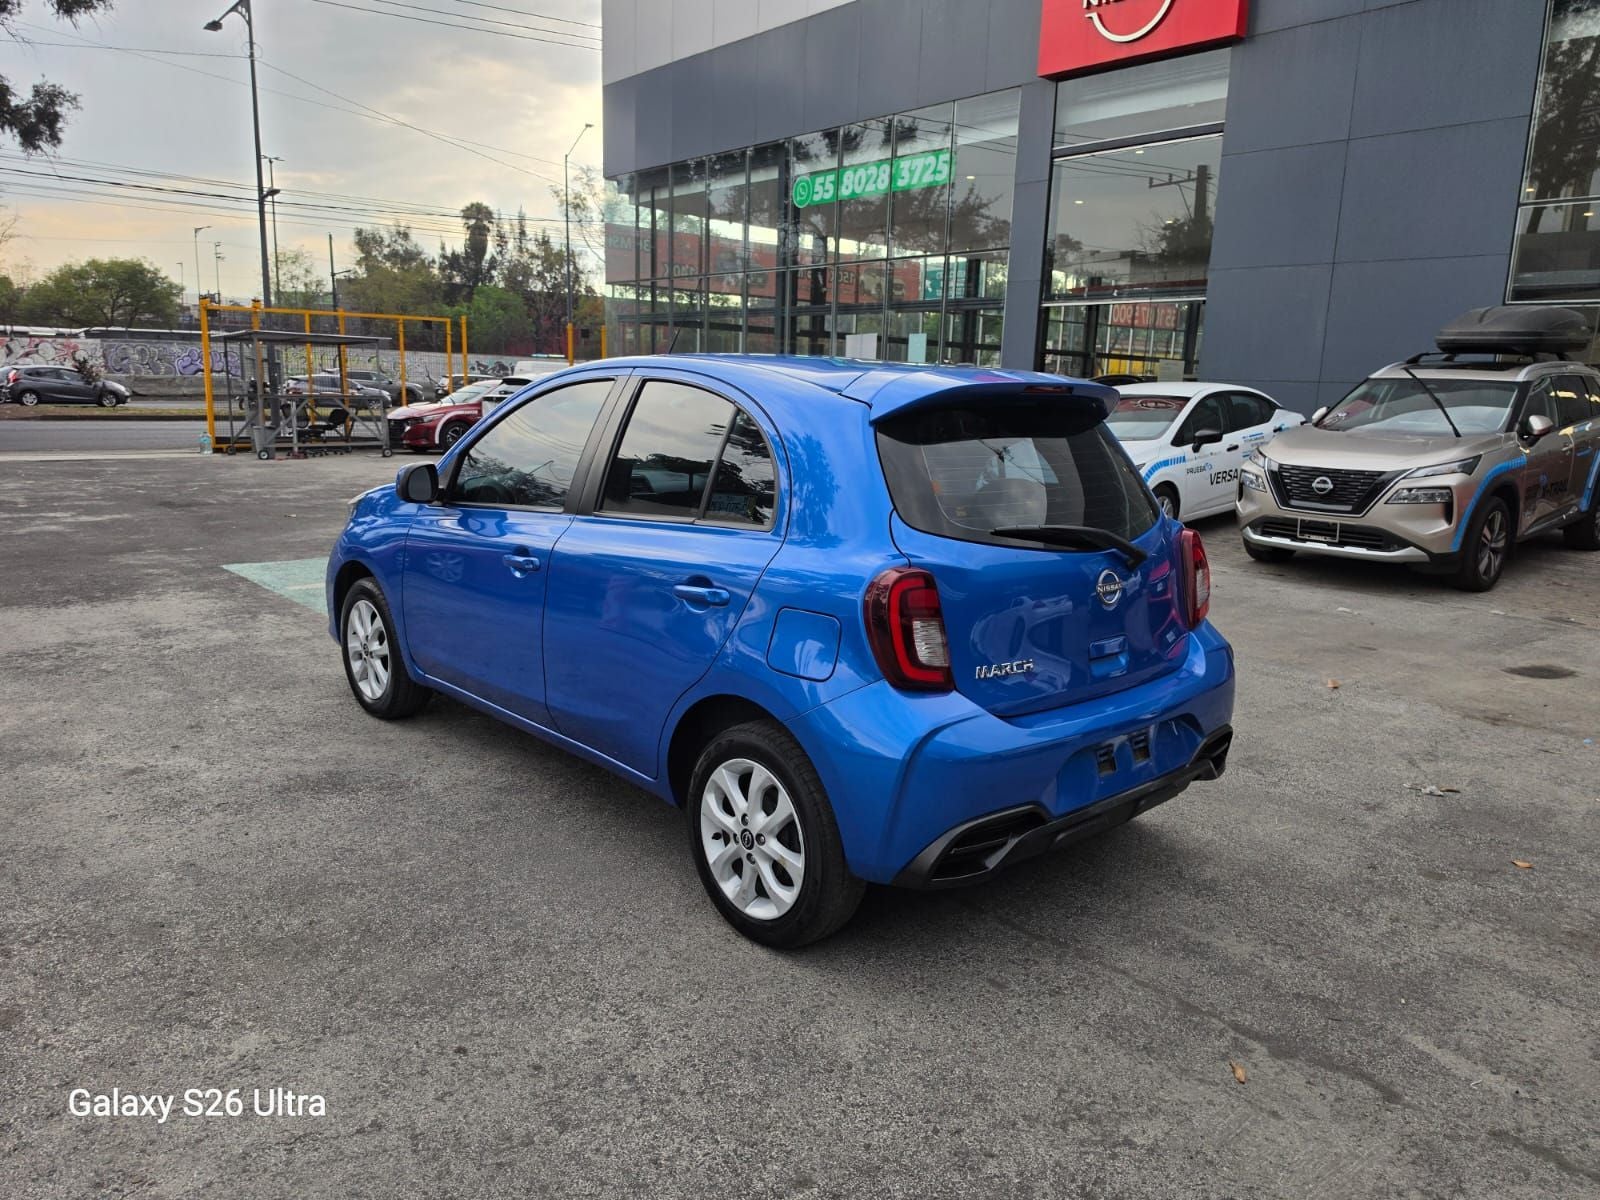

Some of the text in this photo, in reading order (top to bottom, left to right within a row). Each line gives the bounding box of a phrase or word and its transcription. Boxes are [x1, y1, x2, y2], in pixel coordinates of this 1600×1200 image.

[812, 153, 950, 201] 55 8028 3725
[1209, 468, 1239, 486] VERSA
[975, 658, 1034, 680] MARCH
